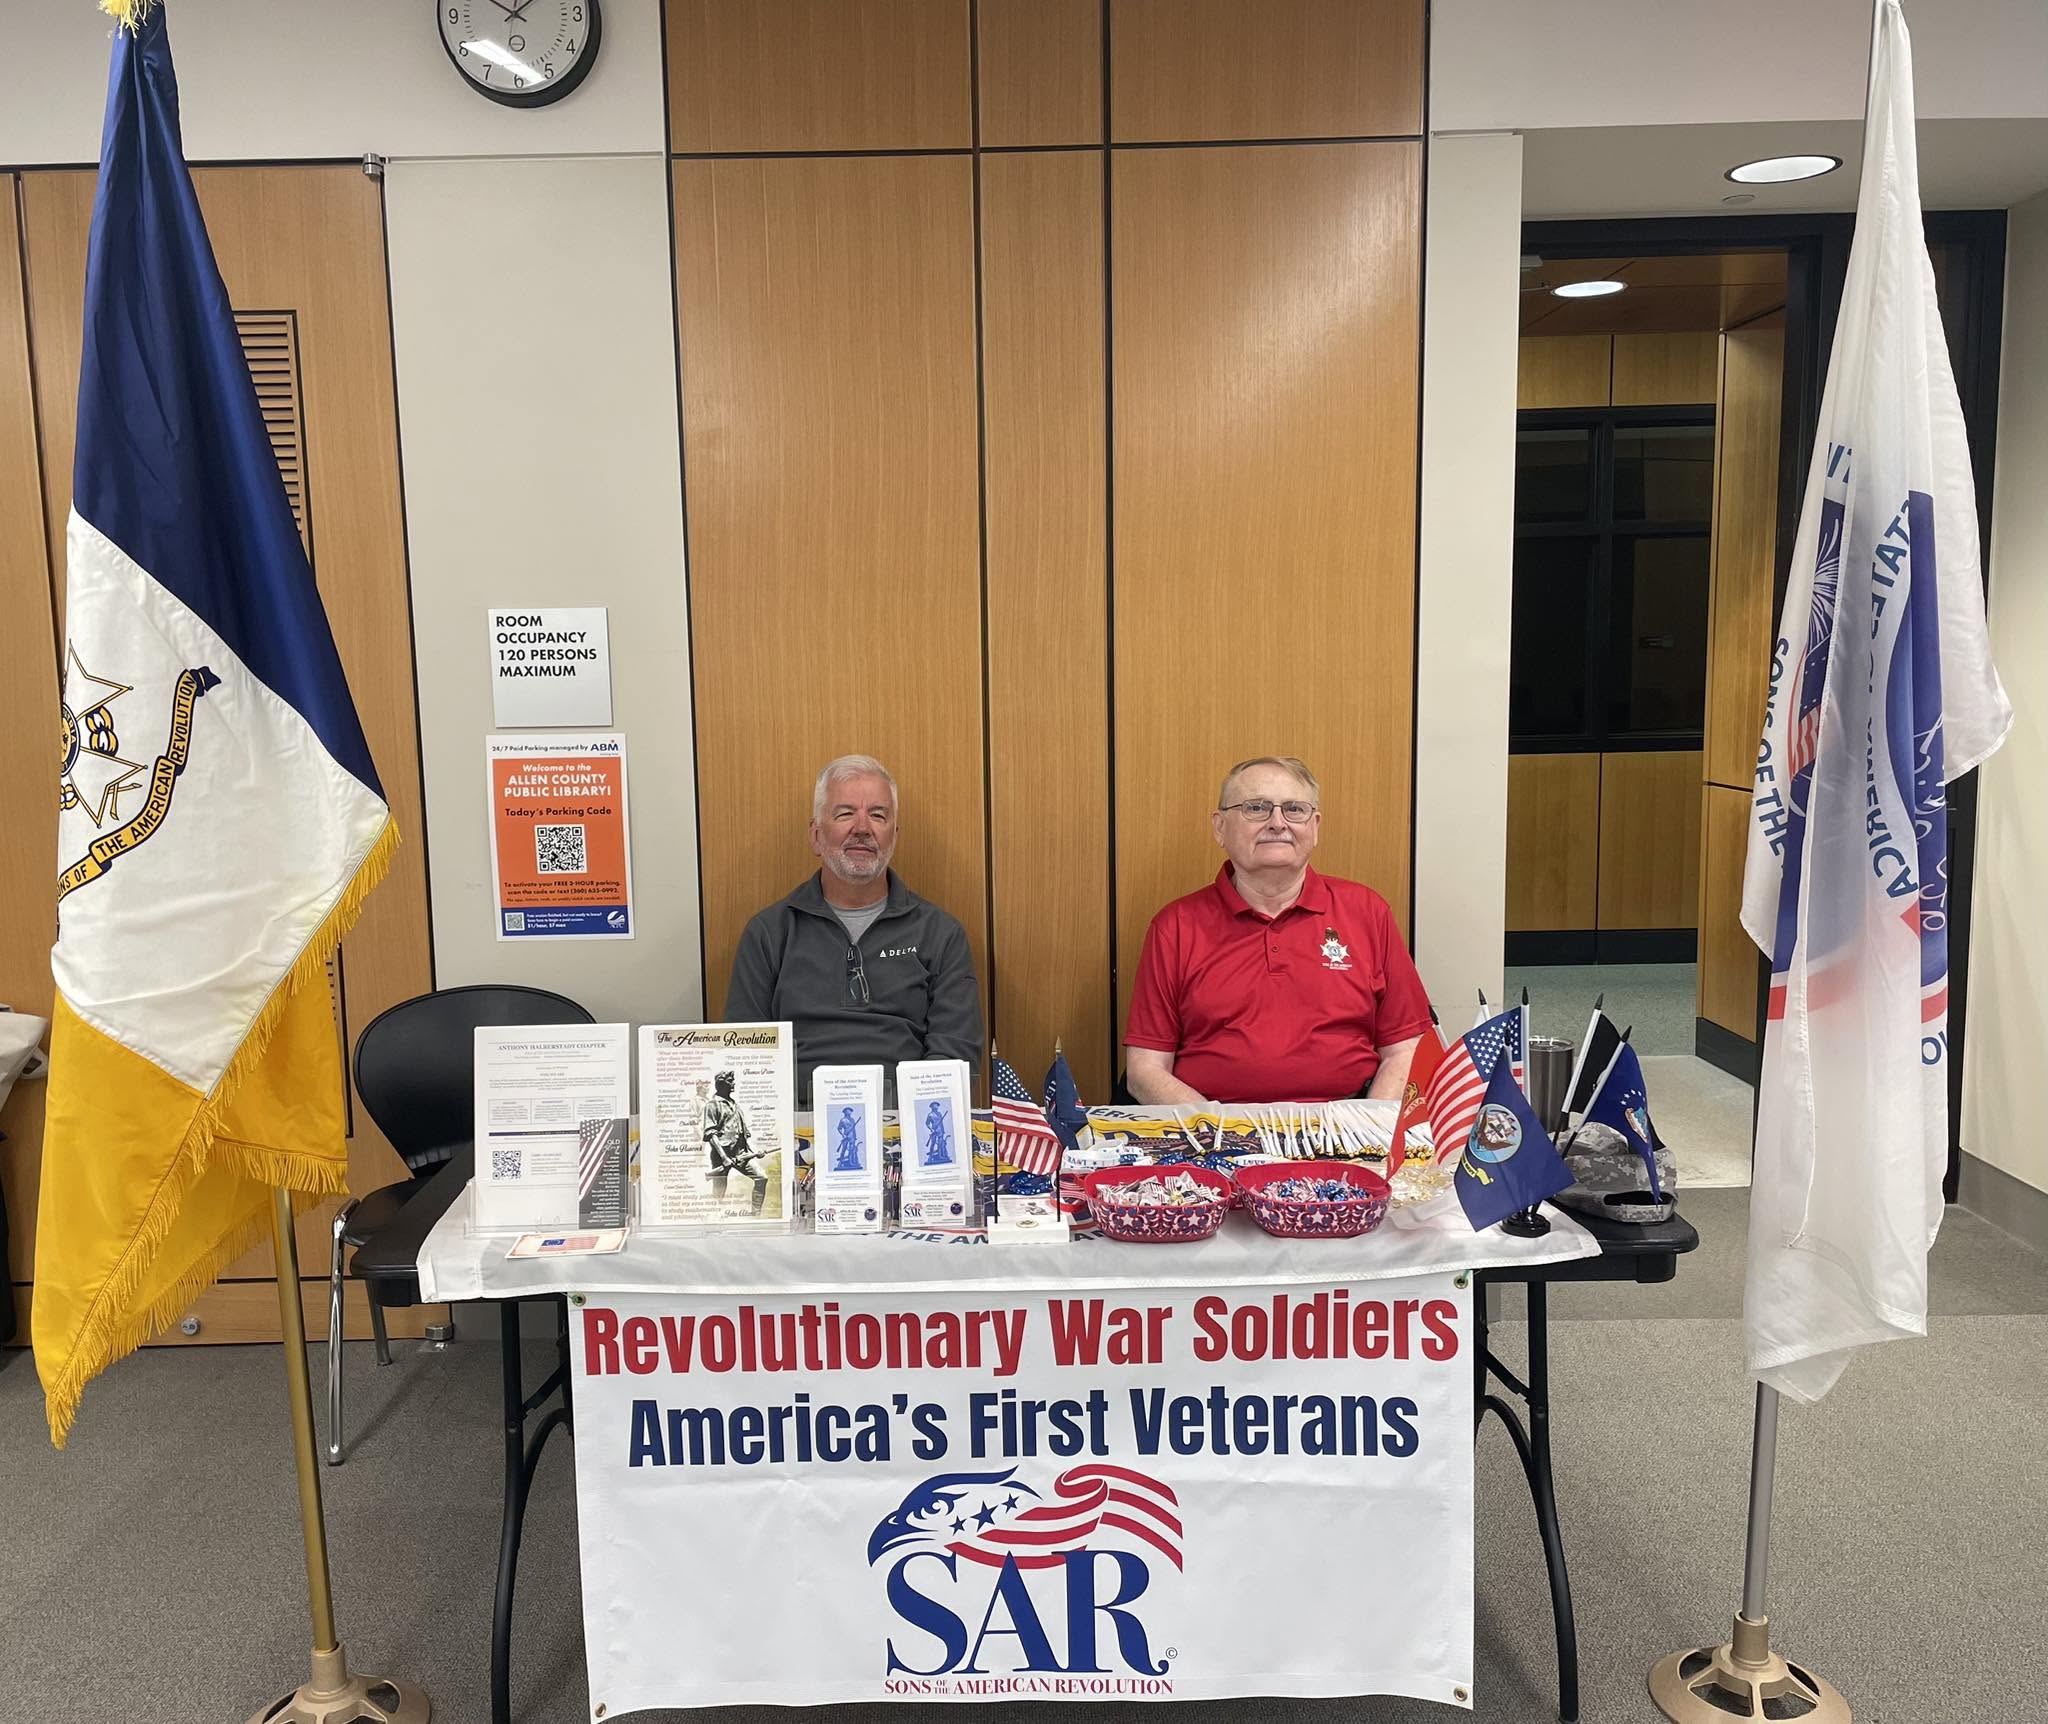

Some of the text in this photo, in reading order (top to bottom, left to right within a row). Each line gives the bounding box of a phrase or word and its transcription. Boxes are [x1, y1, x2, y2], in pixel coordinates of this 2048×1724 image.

[448, 8, 459, 24] 9
[572, 6, 582, 22] 3
[566, 38, 576, 54] 4
[483, 64, 493, 81] 7
[544, 63, 554, 80] 5
[513, 74, 524, 89] 6
[496, 616, 543, 628] ROOM
[496, 632, 587, 644] OCCUPANCY
[499, 649, 597, 661] 120 PERSONS
[499, 665, 576, 677] MAXIMUM
[509, 744, 523, 752] Paid
[524, 744, 548, 752] Parking
[580, 743, 588, 752] by
[590, 743, 619, 752] ABM
[522, 763, 591, 772] Welcome to the
[73, 864, 87, 883] OF
[95, 834, 128, 859] THE
[130, 762, 175, 842] AMERICAN
[170, 675, 197, 767] REVOLUTION
[508, 773, 607, 785] ALLEN COUNTY
[504, 785, 611, 797] PUBLIC LIBRARY!
[505, 806, 612, 818] Today's Parking Code
[889, 946, 917, 957] DELTA
[657, 1030, 777, 1048] The American Revolution
[497, 1043, 528, 1051] ANTHONY
[576, 1042, 606, 1050] CHAPTER
[886, 1230, 944, 1243] THE
[583, 1289, 1459, 1376] Revolutionary War Soldiers
[629, 1386, 1419, 1467] America's First Veterans
[886, 1550, 1170, 1677] SAR
[884, 1679, 932, 1695] SONS
[951, 1677, 1051, 1695] AMERICAN
[1055, 1678, 1175, 1695] REVOLUTION
